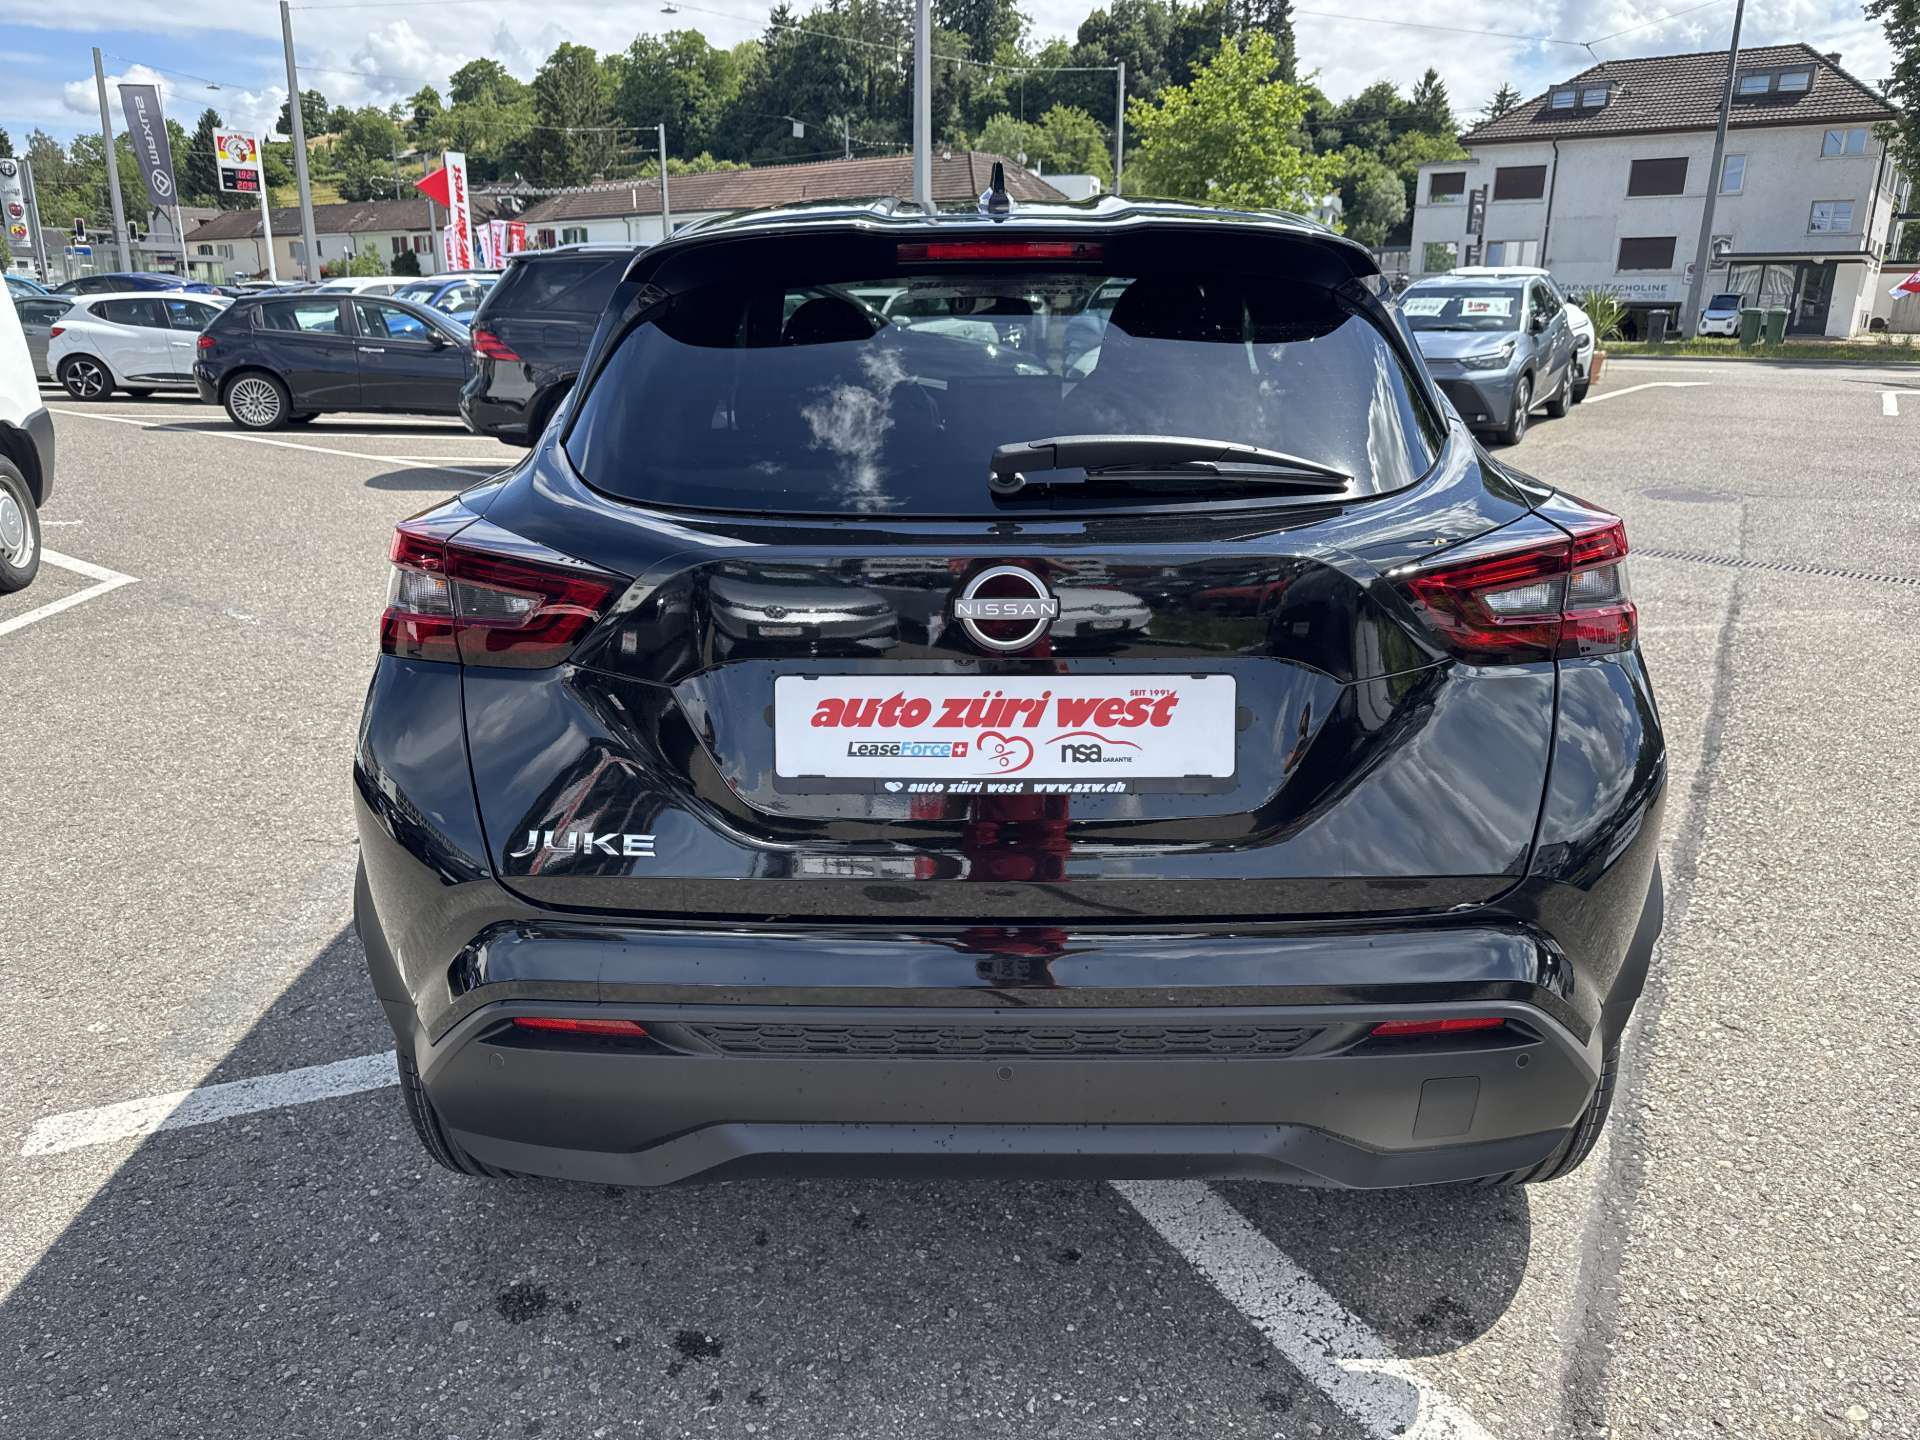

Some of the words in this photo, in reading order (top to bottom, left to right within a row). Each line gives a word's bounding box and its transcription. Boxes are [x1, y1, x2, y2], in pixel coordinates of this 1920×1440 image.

[1604, 283, 1669, 292] TACHOLINE
[957, 602, 1055, 616] NISSAN
[1129, 689, 1147, 697] SEIT
[1150, 689, 1170, 697] 1991
[810, 690, 932, 728] auto
[932, 690, 1052, 728] züri
[1056, 690, 1180, 728] west
[847, 741, 951, 757] LeaseForce
[1061, 743, 1102, 763] nsa
[907, 781, 945, 793] auto
[947, 780, 983, 793] züri
[987, 781, 1024, 793] west
[1033, 781, 1126, 793] www.azw.ch
[510, 830, 657, 858] JUKE
